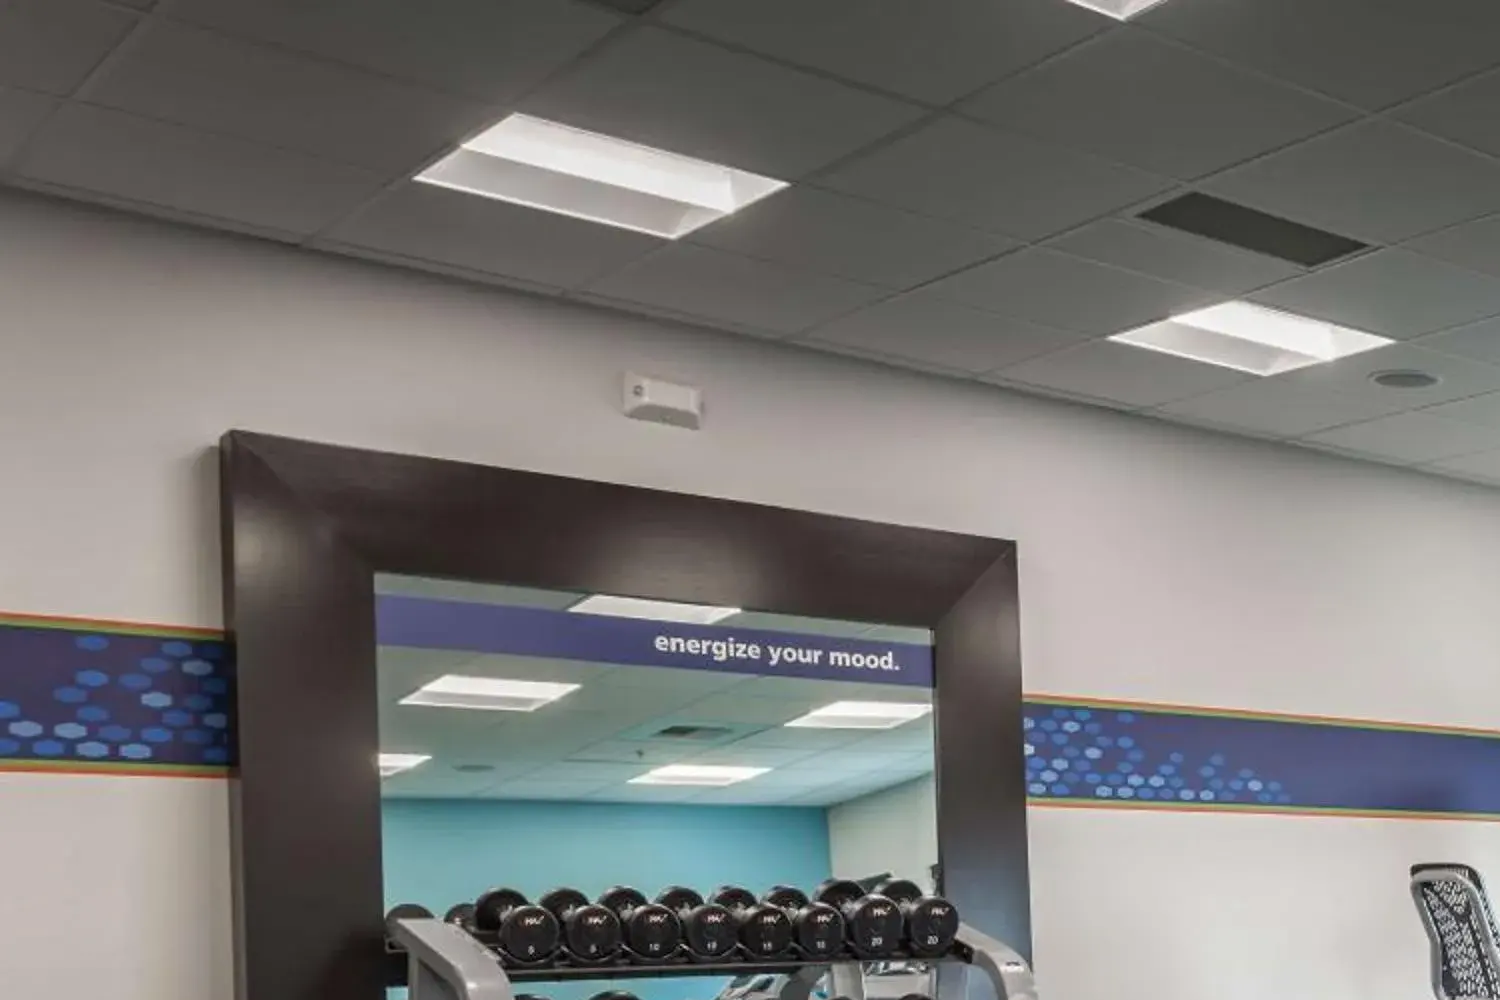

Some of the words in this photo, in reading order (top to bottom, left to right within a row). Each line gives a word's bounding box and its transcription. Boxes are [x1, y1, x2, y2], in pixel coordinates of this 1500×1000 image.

[655, 634, 761, 661] energize
[767, 645, 823, 666] your
[828, 651, 901, 671] mood.
[871, 935, 884, 947] 20
[927, 934, 940, 946] 20
